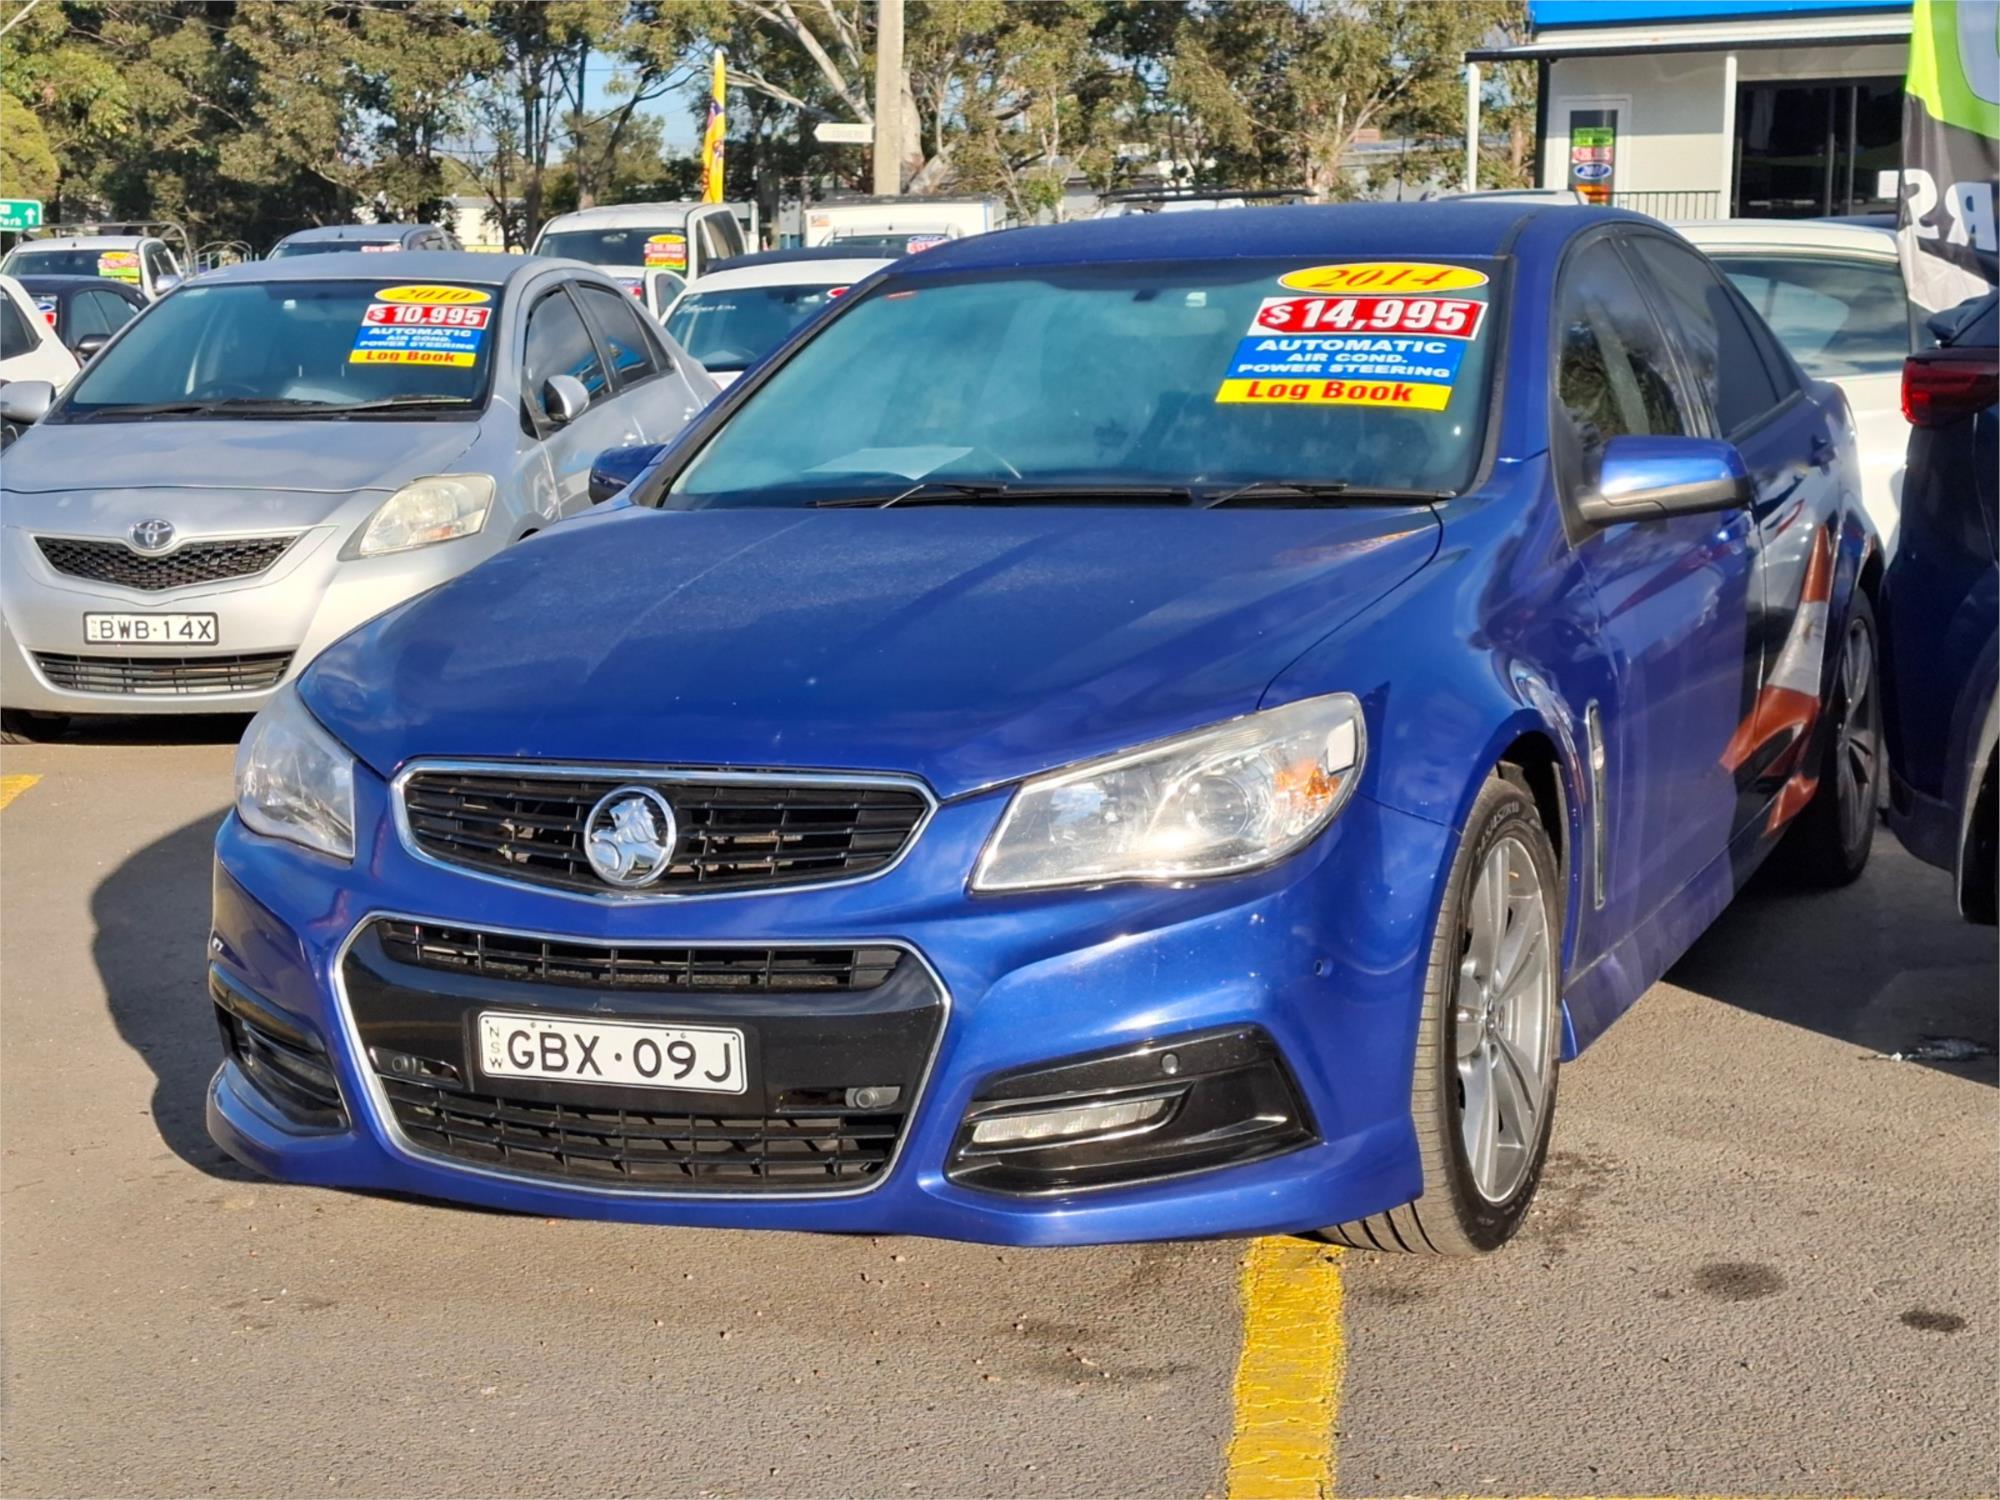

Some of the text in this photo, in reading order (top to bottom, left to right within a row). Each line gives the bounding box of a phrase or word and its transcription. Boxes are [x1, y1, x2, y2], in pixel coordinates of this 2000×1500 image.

[1308, 269, 1453, 287] 2014
[397, 289, 472, 300] 2010
[368, 327, 472, 337] AUTOMATIC
[409, 341, 475, 350] STEERING
[1256, 339, 1447, 354] AUTOMATIC
[366, 351, 455, 363] Log Book
[1286, 353, 1408, 363] AIR COND.
[1238, 363, 1450, 378] POWER STEERING
[1247, 381, 1413, 402] Log Book
[488, 1026, 503, 1069] NSW
